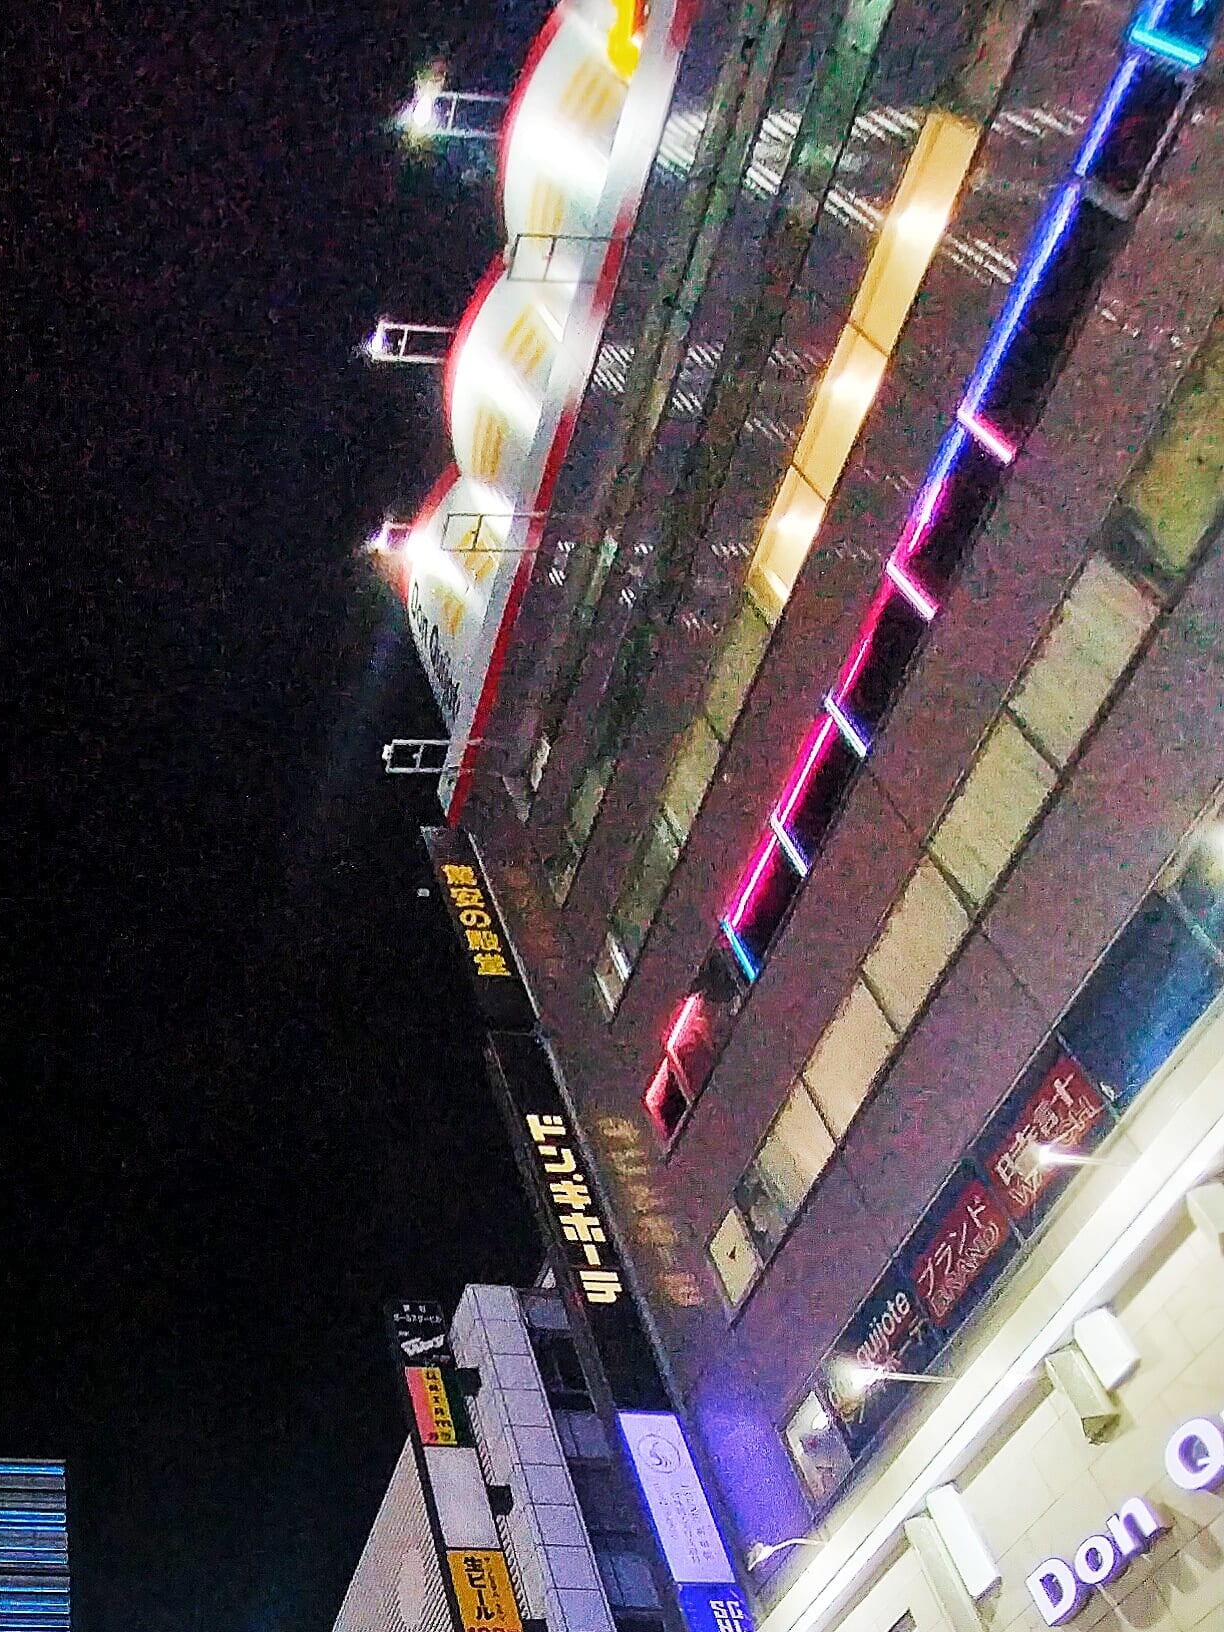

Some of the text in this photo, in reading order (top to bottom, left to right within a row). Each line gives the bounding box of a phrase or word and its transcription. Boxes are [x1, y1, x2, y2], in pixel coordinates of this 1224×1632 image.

[463, 1556, 496, 1621] 生ビール
[1025, 1496, 1162, 1627] Don
